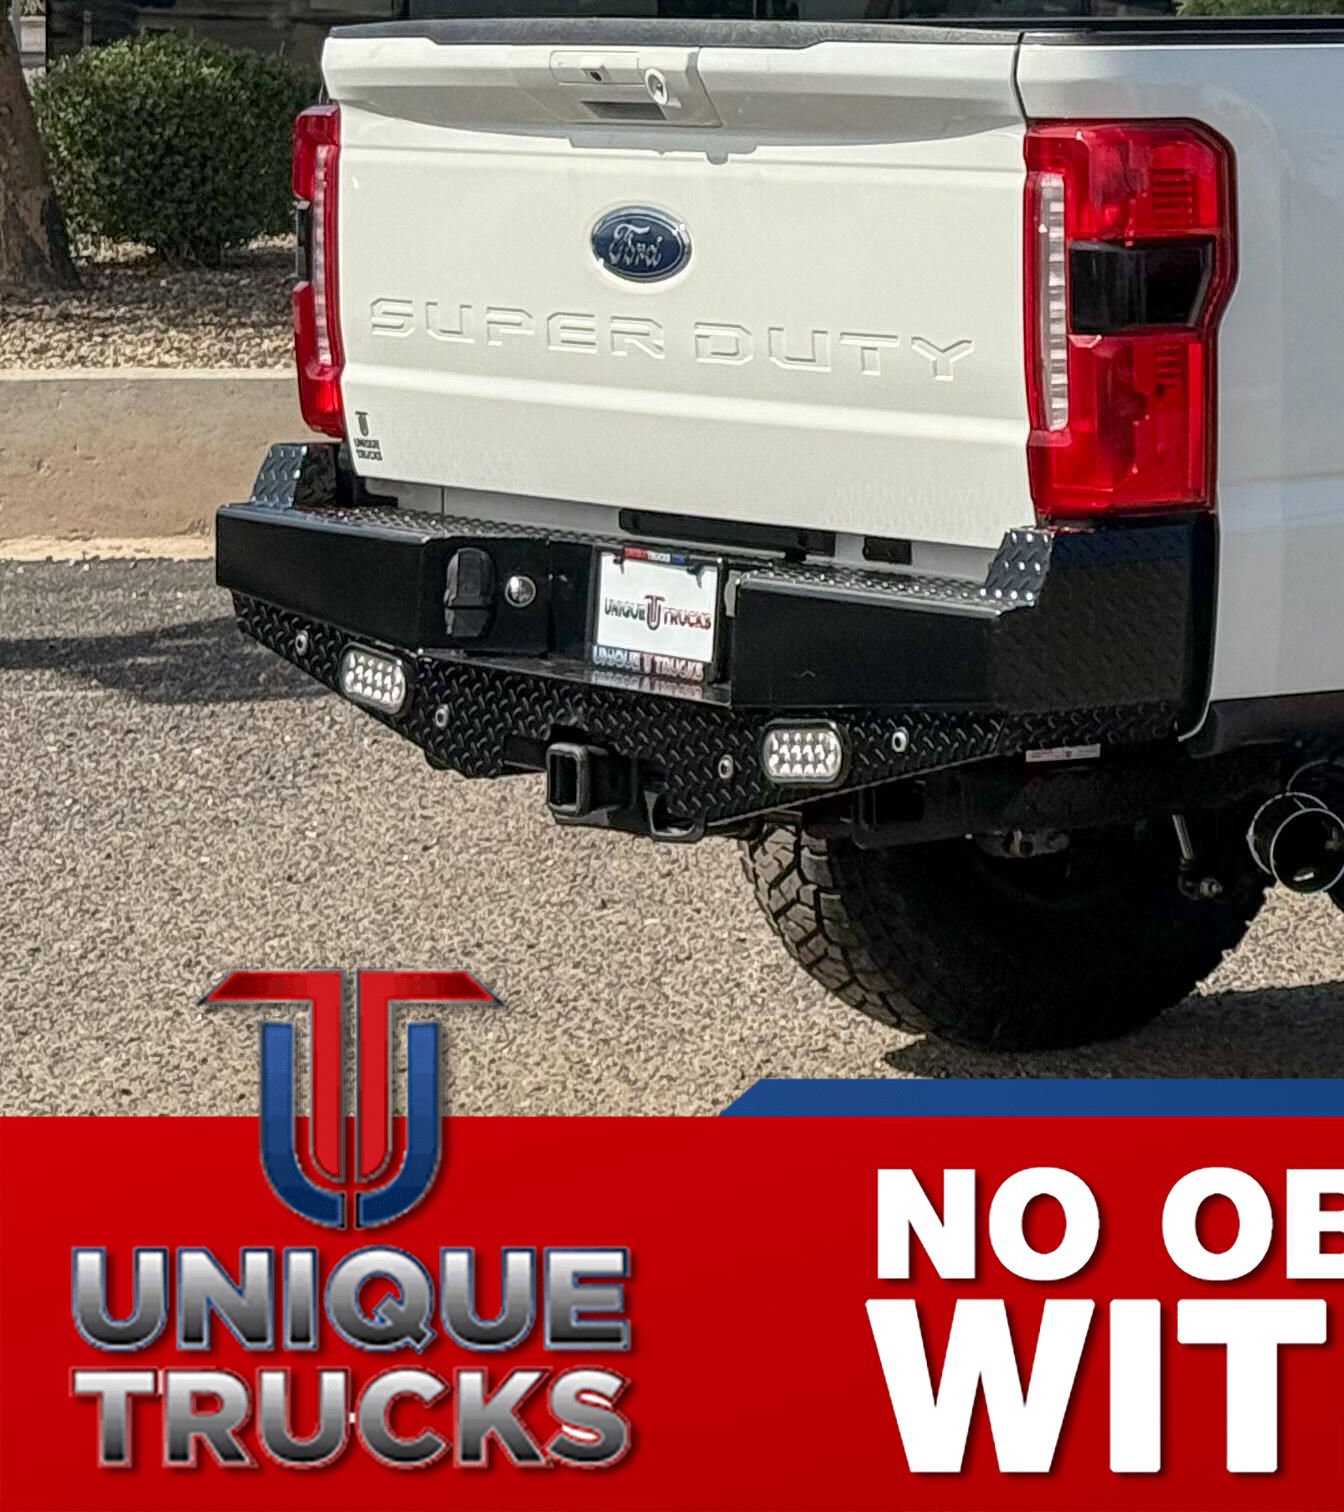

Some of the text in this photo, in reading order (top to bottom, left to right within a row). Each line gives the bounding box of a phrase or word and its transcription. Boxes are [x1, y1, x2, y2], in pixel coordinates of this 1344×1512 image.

[608, 223, 663, 267] Ford
[370, 297, 975, 382] SUPER DUTY
[604, 597, 646, 622] UNIQUE
[663, 606, 712, 630] TRUCKS
